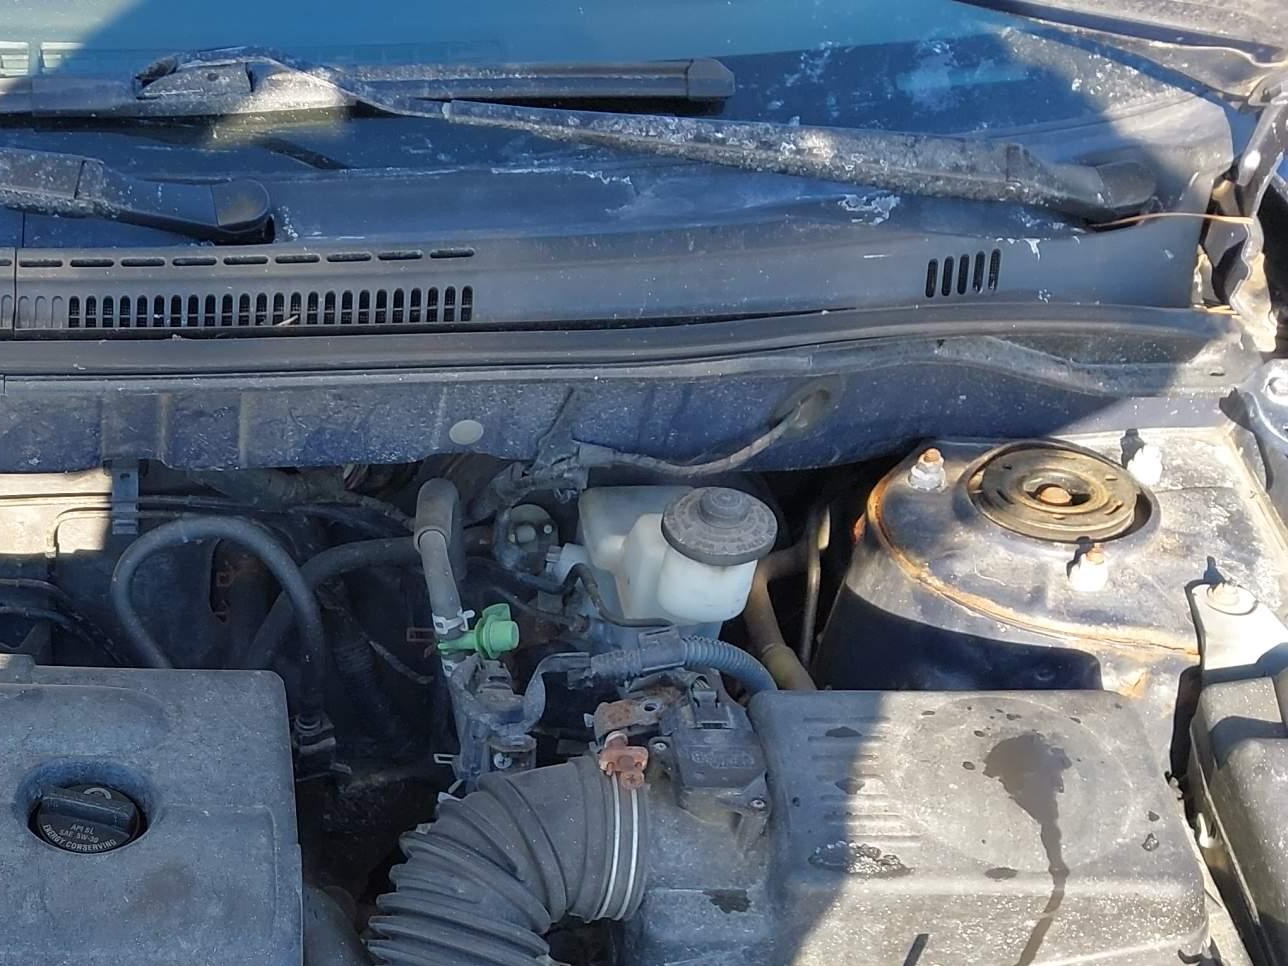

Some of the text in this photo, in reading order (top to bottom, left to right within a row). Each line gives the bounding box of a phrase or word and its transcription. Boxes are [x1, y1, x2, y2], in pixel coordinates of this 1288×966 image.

[43, 823, 118, 852] ENERGY CONSERVING
[58, 829, 100, 844] SAE 5W-30
[83, 826, 95, 835] SL
